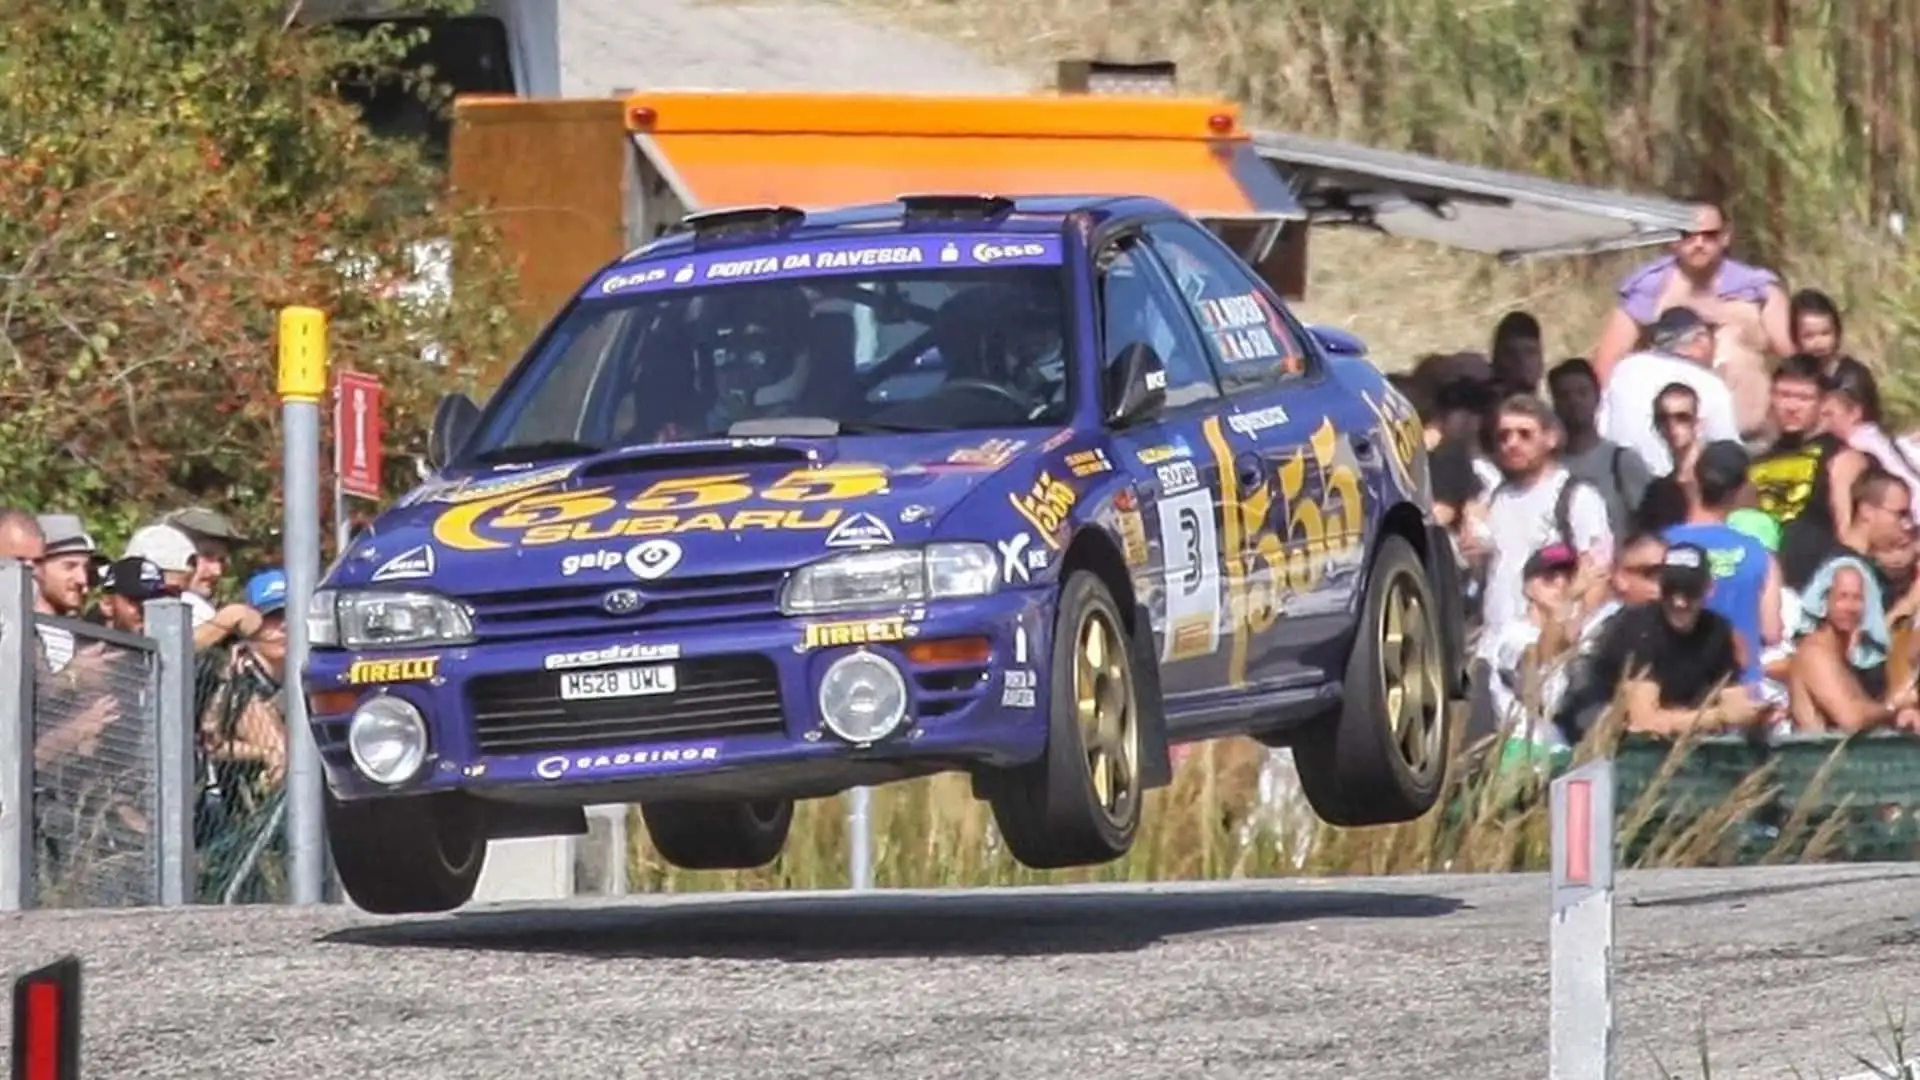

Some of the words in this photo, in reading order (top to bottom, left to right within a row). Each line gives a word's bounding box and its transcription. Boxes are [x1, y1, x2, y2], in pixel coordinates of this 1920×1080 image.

[706, 257, 779, 279] PORTA
[783, 254, 813, 270] DA
[487, 463, 892, 528] 555
[521, 508, 842, 545] SUBARU
[1240, 417, 1363, 633] 555
[562, 550, 624, 576] galp
[1179, 506, 1204, 596] 3
[805, 617, 905, 648] PIRELLI
[350, 656, 440, 684] PIRELLI
[546, 643, 680, 669] prodrive
[568, 673, 619, 694] M528
[629, 668, 667, 689] UWL
